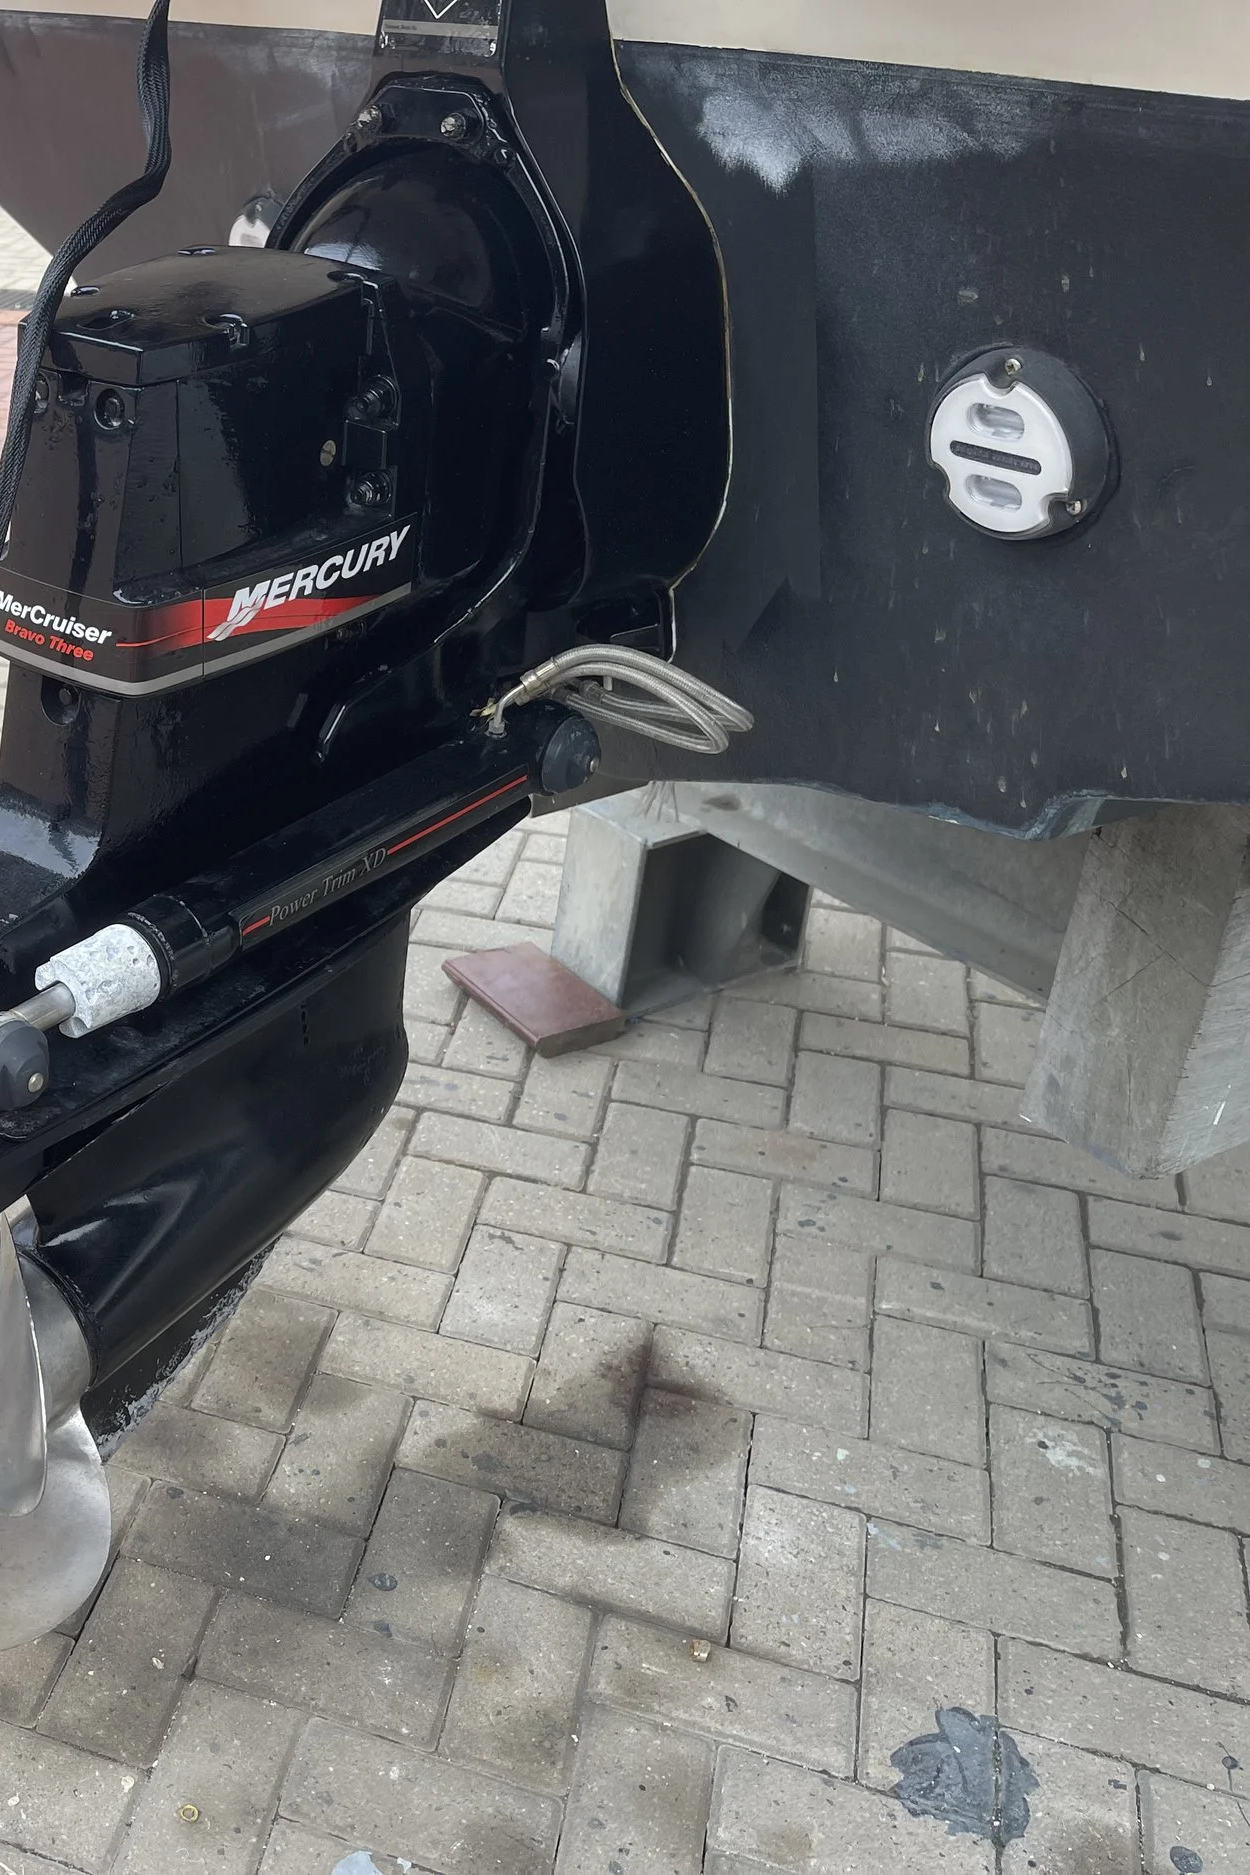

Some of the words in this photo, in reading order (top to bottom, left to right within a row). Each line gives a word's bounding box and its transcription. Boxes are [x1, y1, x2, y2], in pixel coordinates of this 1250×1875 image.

[218, 525, 410, 632] MERCURY
[4, 619, 45, 645] Bravo
[49, 635, 94, 661] Three
[269, 888, 318, 926] Power
[322, 869, 355, 897] Trim
[360, 848, 386, 876] XD
